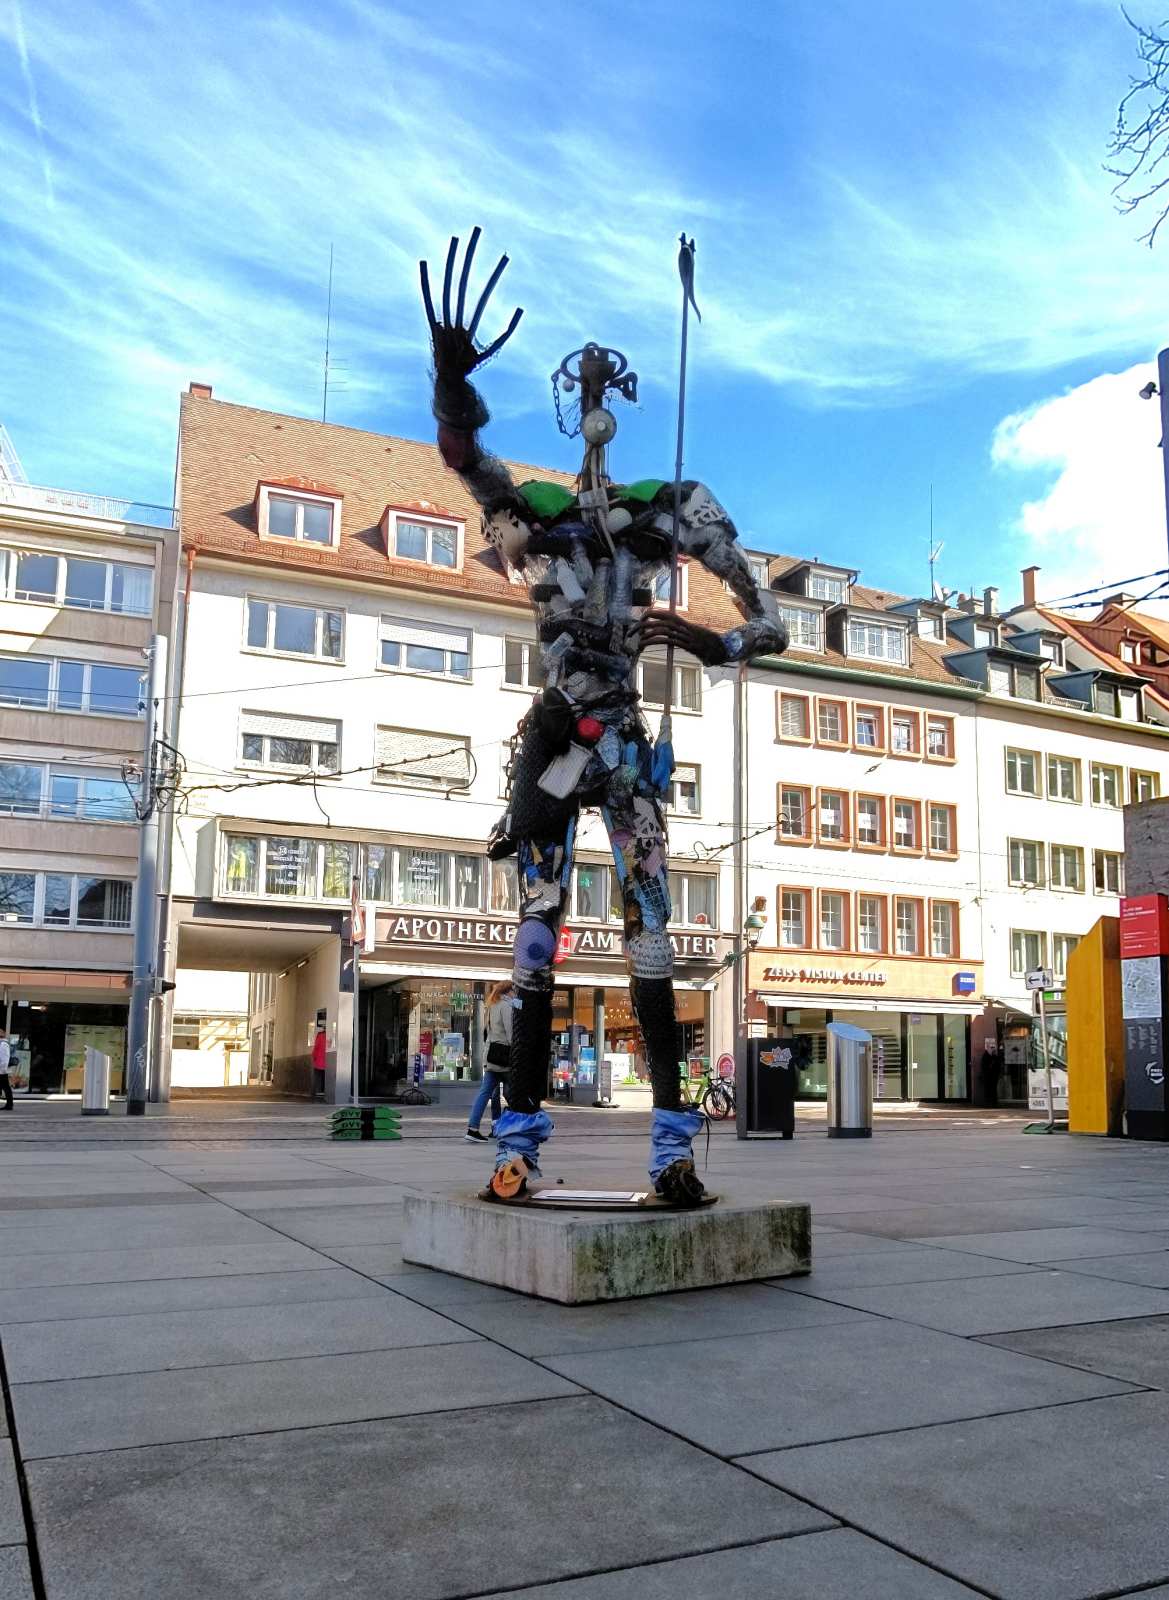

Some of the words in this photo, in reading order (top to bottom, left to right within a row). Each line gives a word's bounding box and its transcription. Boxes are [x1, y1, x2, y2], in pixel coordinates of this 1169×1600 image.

[394, 917, 517, 943] APOTHEKE
[581, 930, 614, 949] AM
[669, 935, 717, 955] ATER
